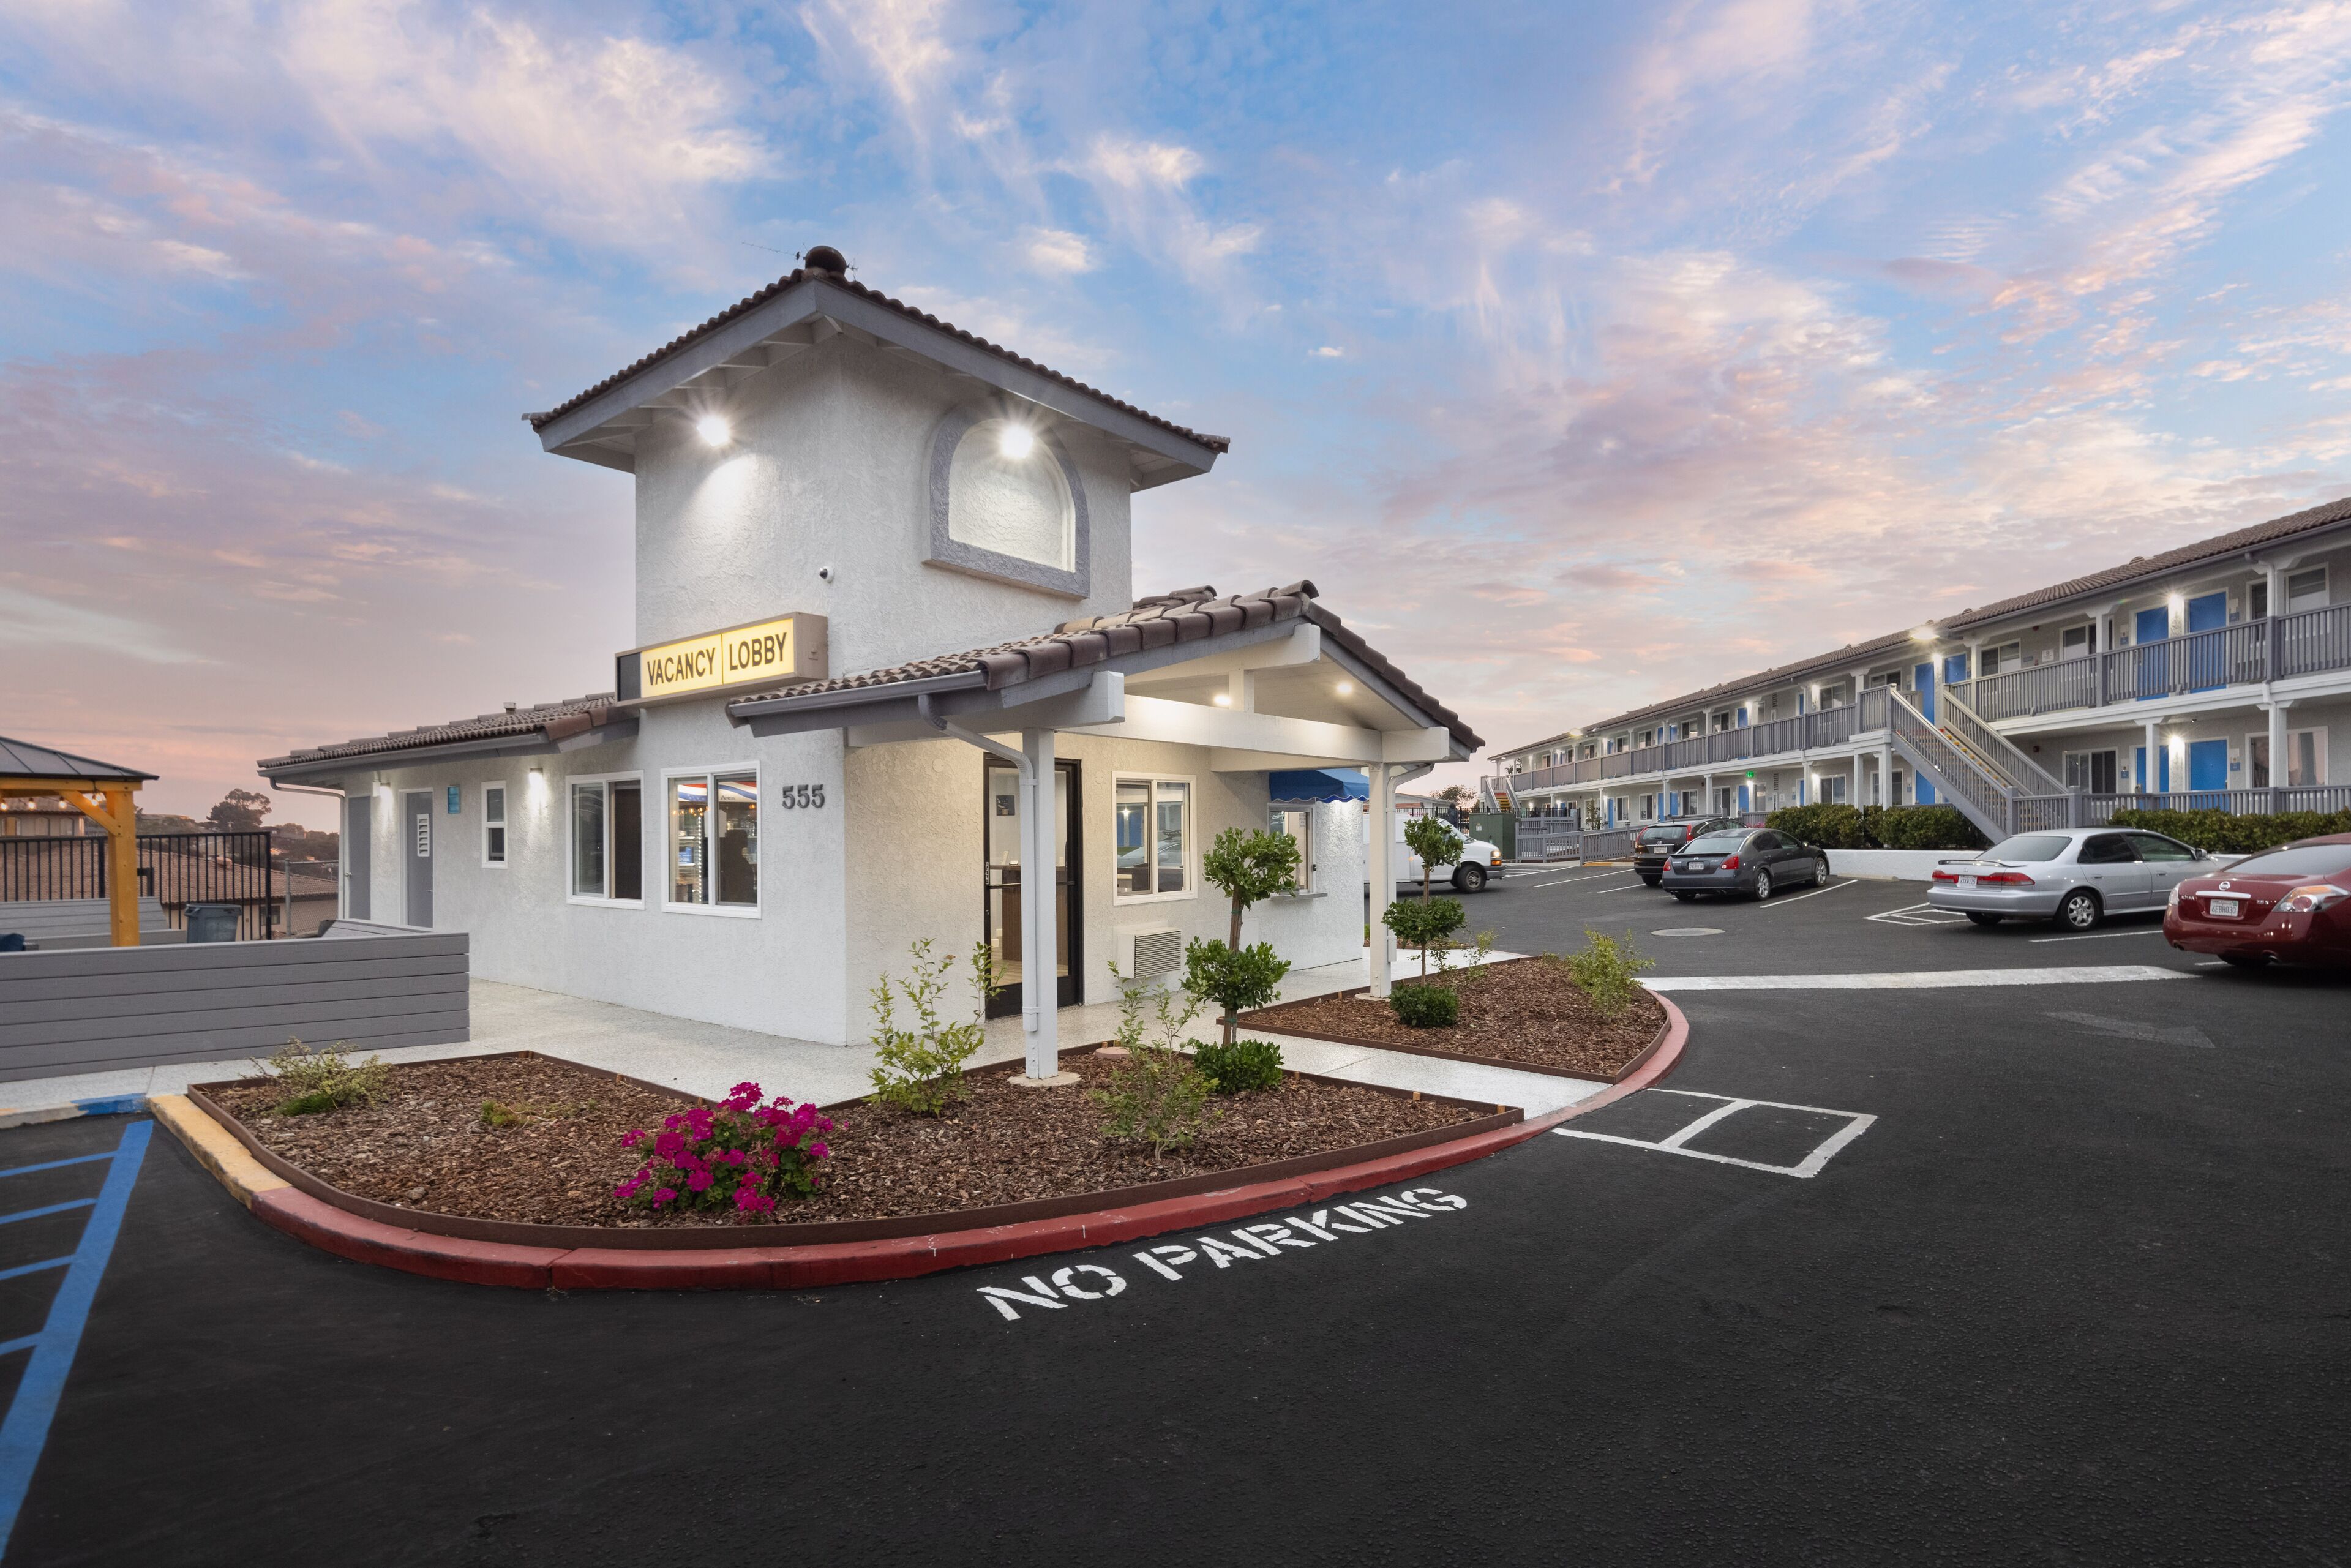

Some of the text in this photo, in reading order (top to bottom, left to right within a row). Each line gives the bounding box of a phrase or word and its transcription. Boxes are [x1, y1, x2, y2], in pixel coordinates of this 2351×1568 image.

[647, 632, 787, 686] VACANCY LOBBY
[782, 784, 825, 809] 555
[2211, 905, 2237, 914] 6EBH030
[976, 1188, 1468, 1321] NO PARKING
